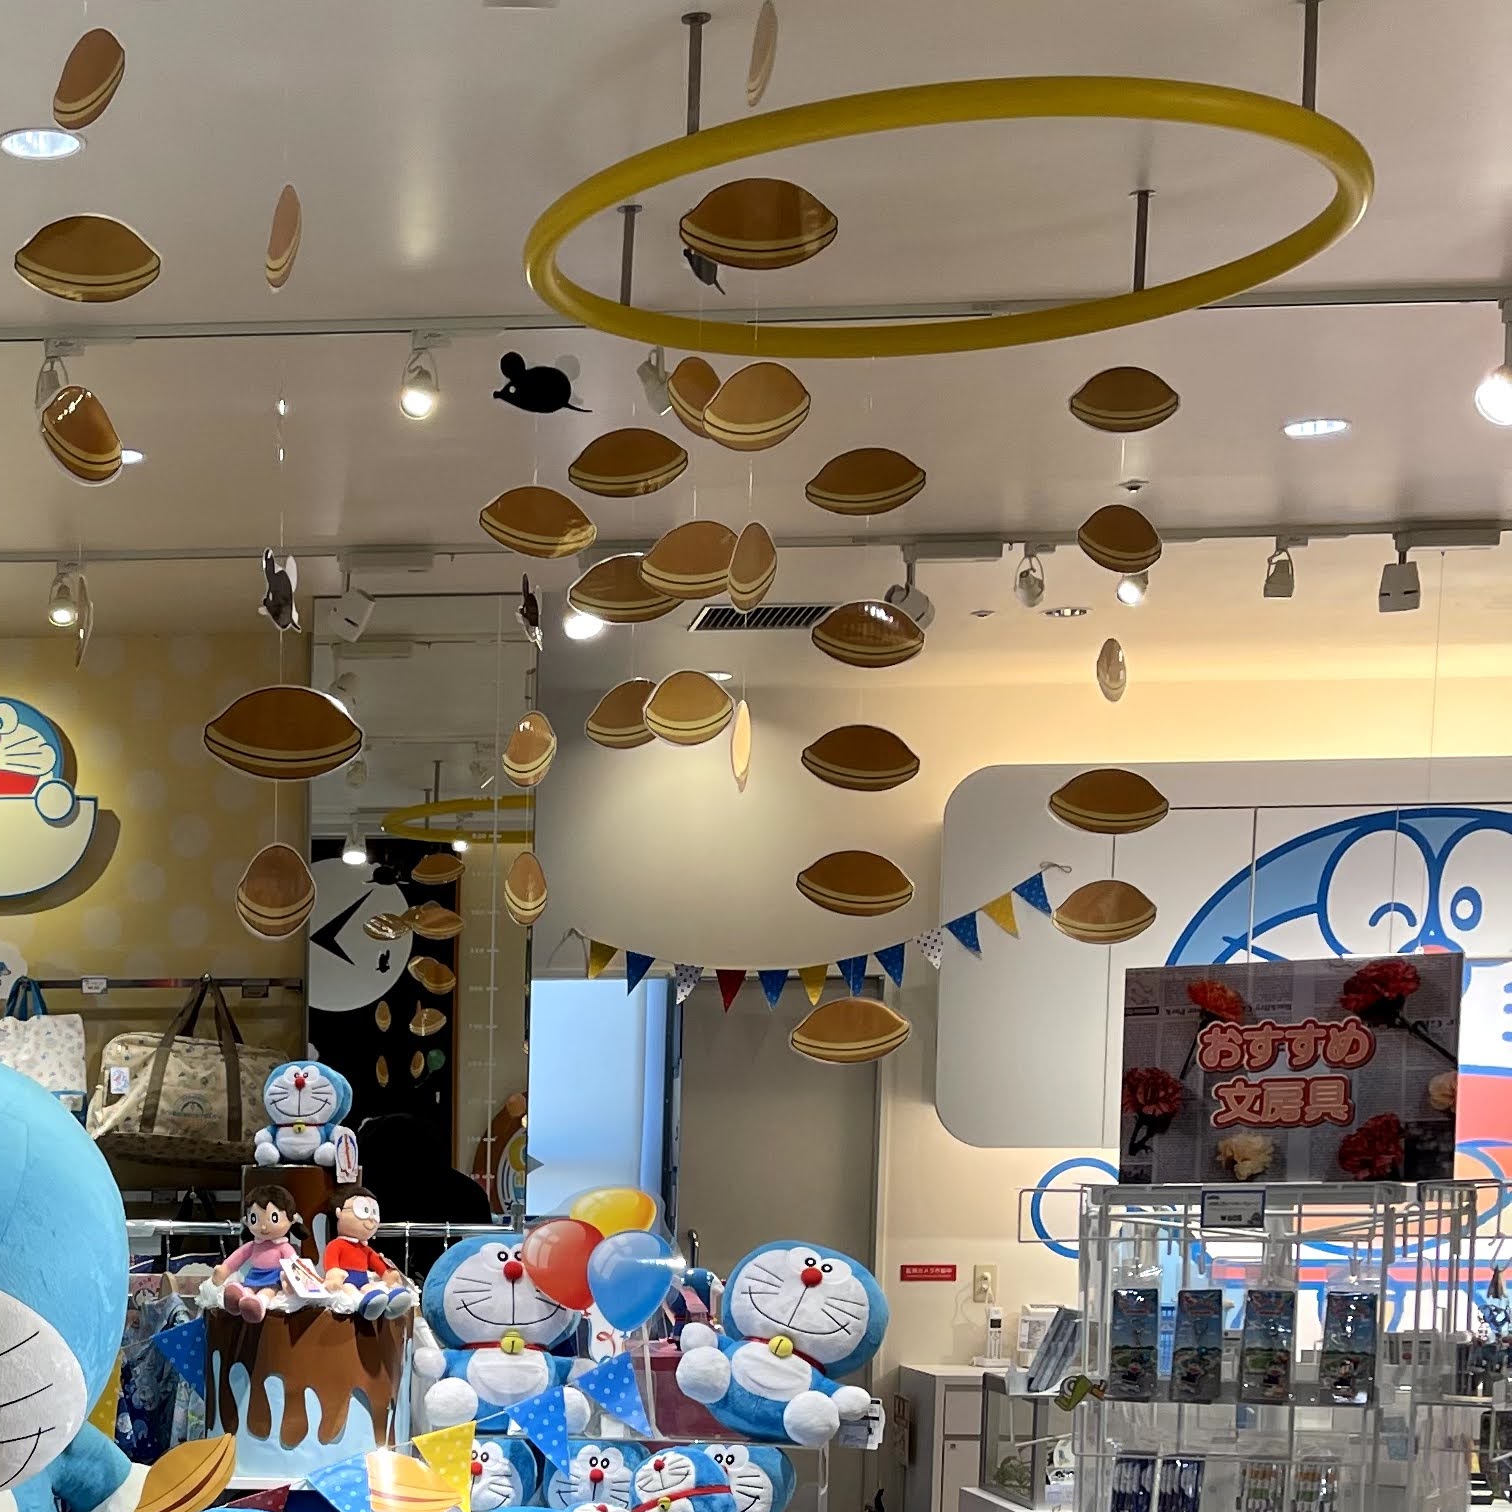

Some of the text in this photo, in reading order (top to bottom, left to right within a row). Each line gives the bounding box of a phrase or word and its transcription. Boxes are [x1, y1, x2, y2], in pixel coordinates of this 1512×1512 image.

[1198, 1016, 1376, 1072] おすすめ
[1211, 1075, 1355, 1129] 文房具
